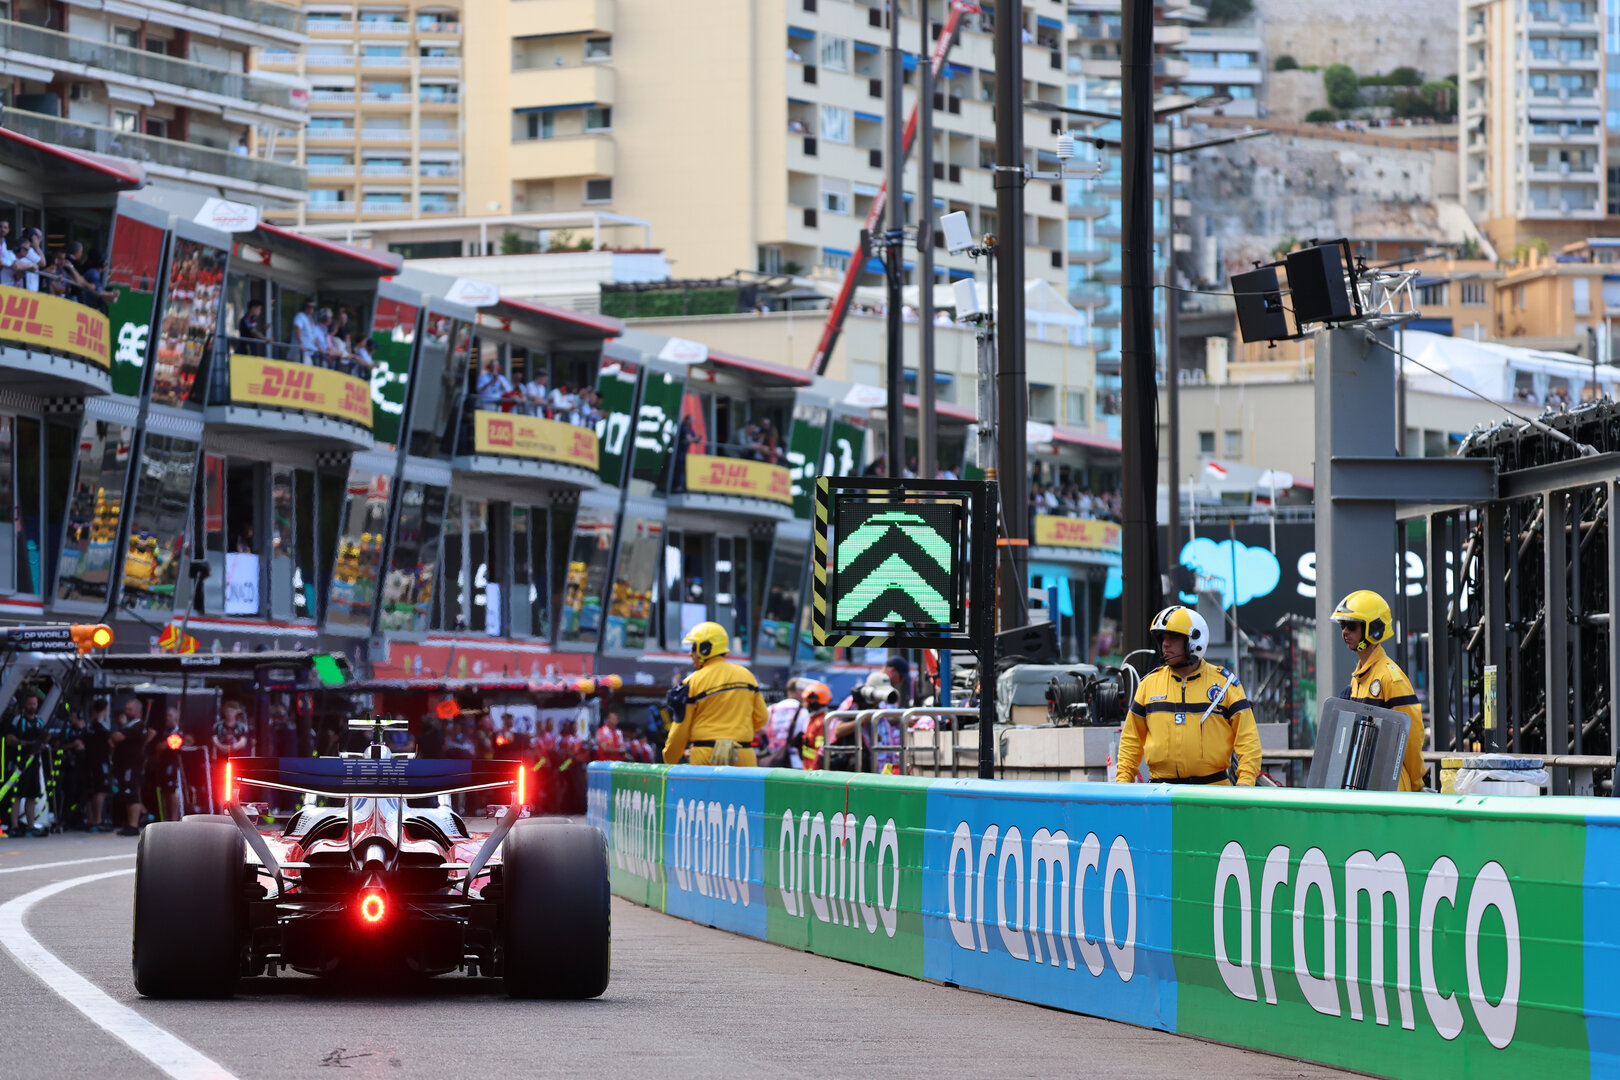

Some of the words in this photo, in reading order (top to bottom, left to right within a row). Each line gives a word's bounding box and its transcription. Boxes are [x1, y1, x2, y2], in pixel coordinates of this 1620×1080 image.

[0, 292, 43, 336] HL
[75, 311, 107, 358] DHL
[260, 365, 318, 403] DHL
[343, 381, 369, 418] DHL
[710, 462, 752, 489] DHL
[1053, 521, 1089, 542] DHL
[24, 631, 37, 639] DP
[37, 630, 70, 639] WORLD
[31, 641, 43, 649] DP
[44, 641, 75, 649] WORLD
[342, 759, 409, 786] IBM
[674, 798, 750, 907] aramco
[779, 807, 899, 938] aramco
[947, 820, 1137, 983] aramco
[1213, 840, 1522, 1050] aramco
